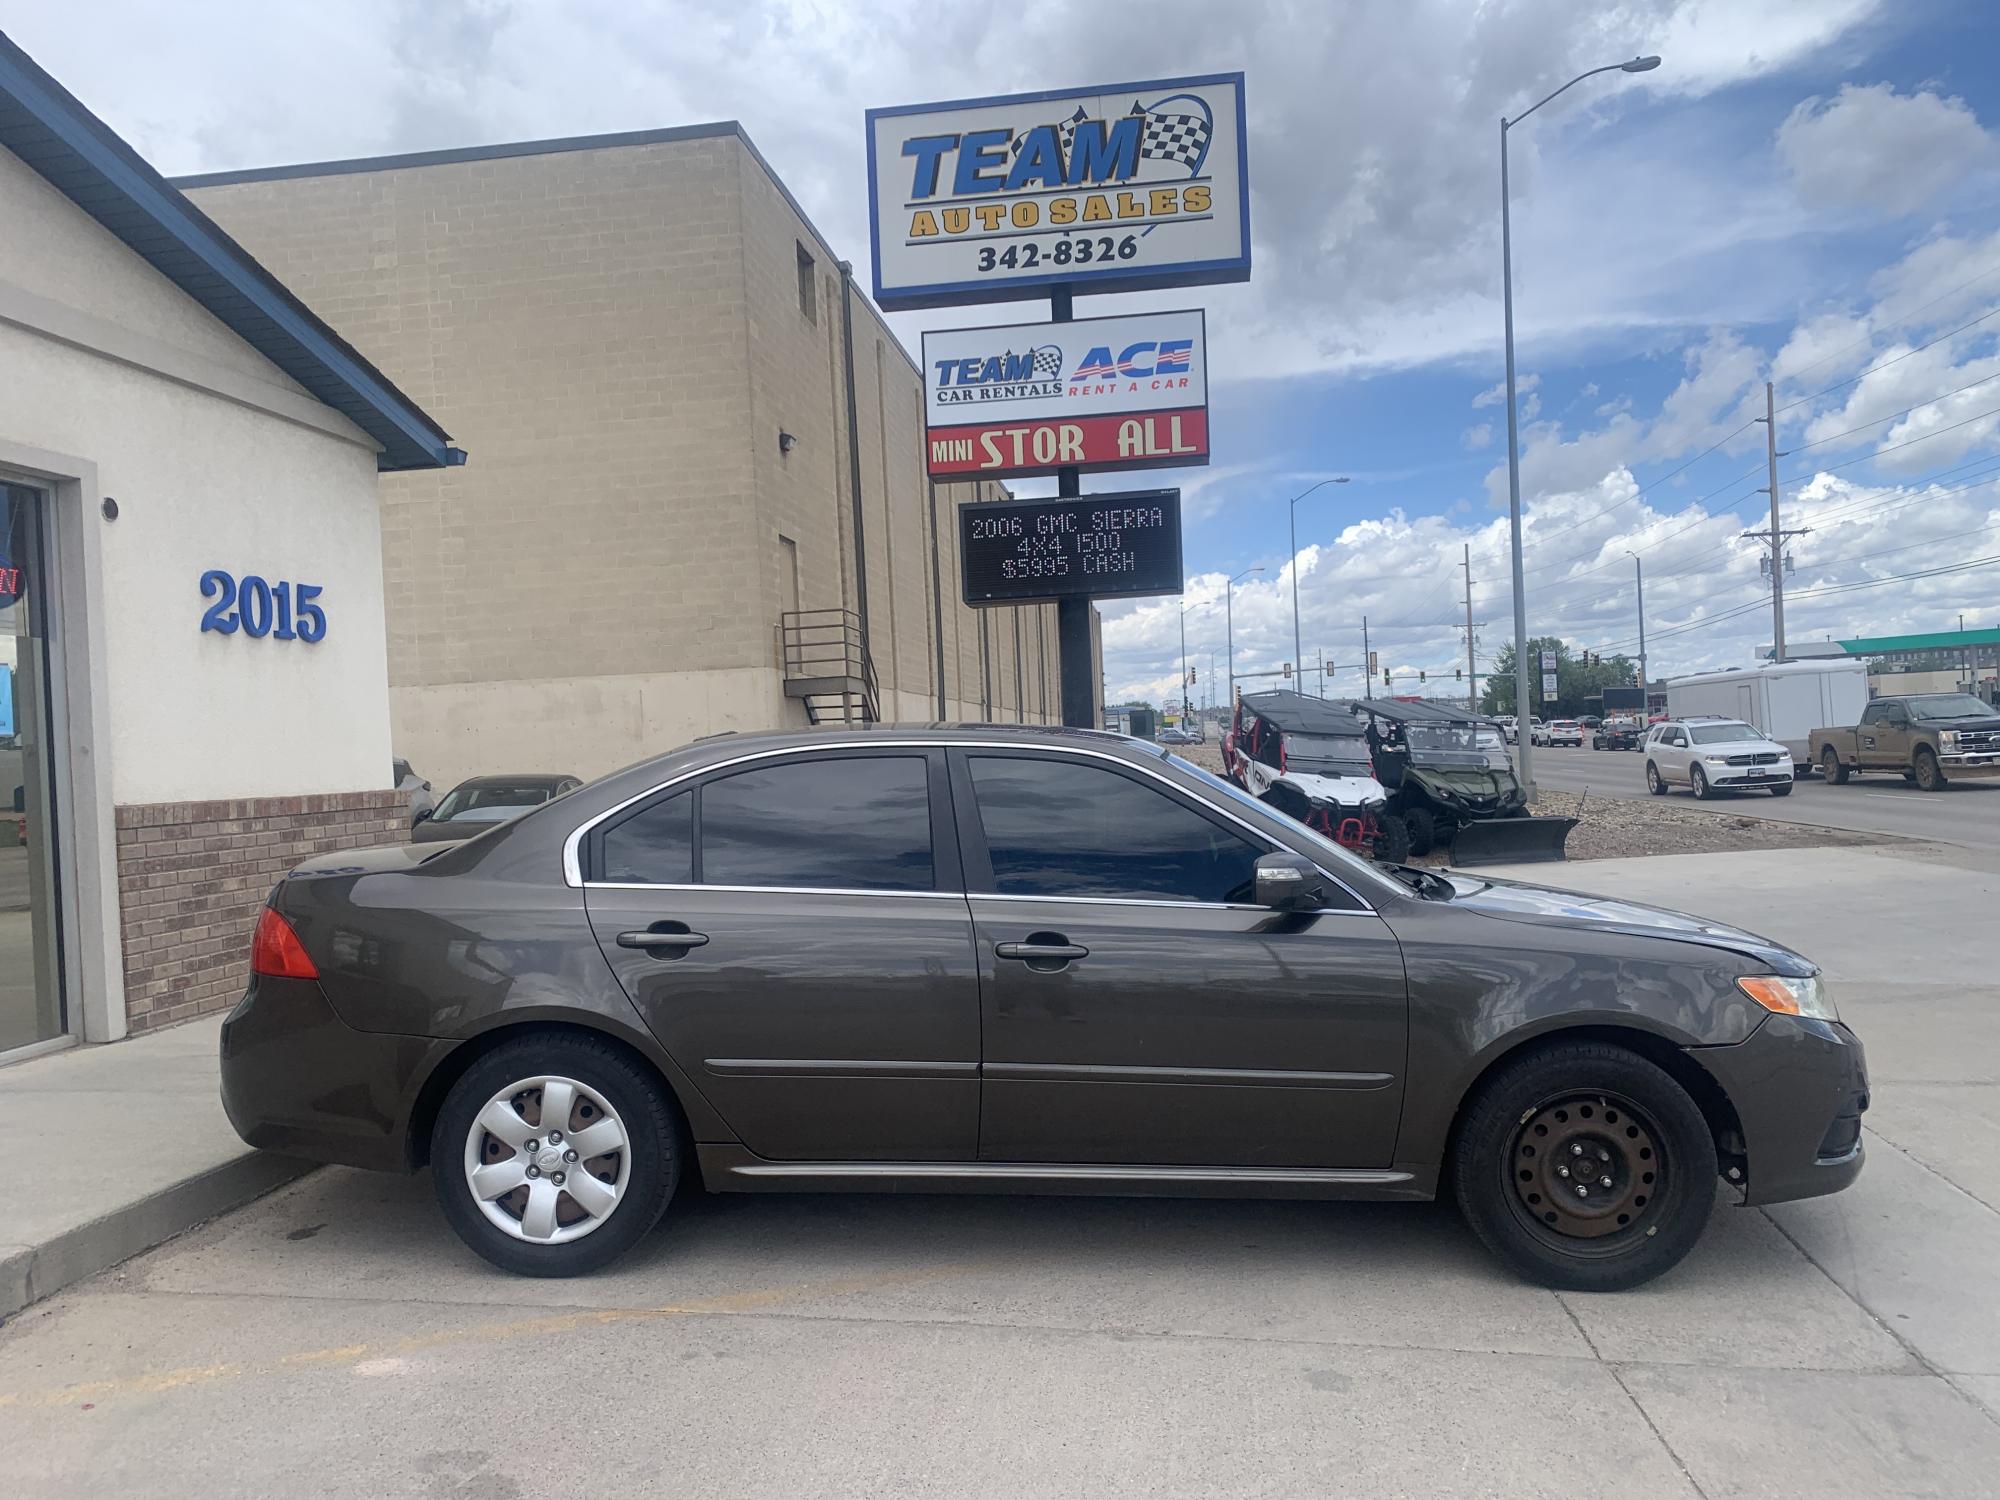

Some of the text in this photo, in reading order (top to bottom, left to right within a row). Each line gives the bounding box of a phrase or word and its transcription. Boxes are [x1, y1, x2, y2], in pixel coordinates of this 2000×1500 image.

[901, 116, 1147, 199] TEAM
[977, 234, 1137, 272] 342-8326
[934, 353, 1036, 387] TEAM
[1070, 339, 1193, 382] ACE
[937, 382, 1063, 403] CAR RENTALS
[1068, 378, 1190, 397] RENT A CAR
[932, 415, 1197, 468] MINI STOR ALL
[972, 507, 1162, 539] 2006 GMC SIERRA
[1076, 531, 1121, 553] 1500
[1002, 551, 1136, 579] $5995 CASH
[200, 570, 327, 643] 2015
